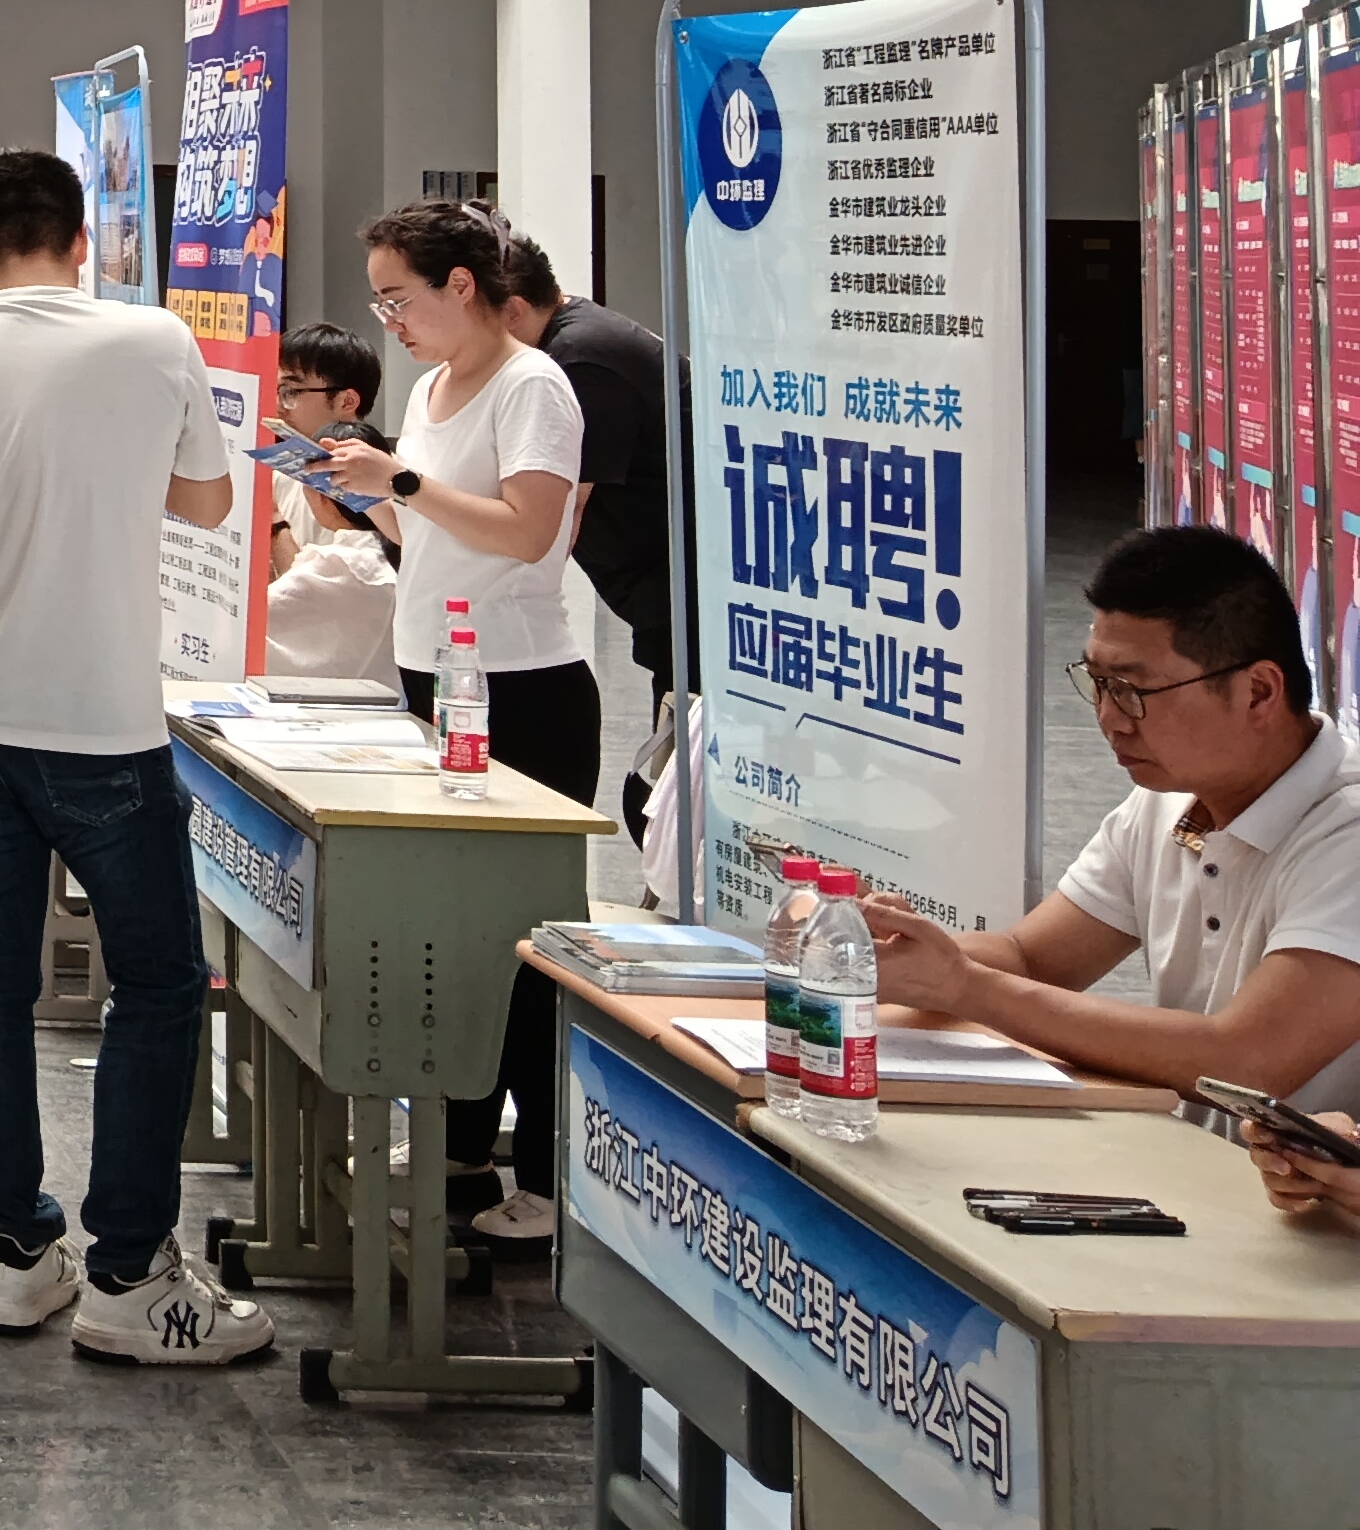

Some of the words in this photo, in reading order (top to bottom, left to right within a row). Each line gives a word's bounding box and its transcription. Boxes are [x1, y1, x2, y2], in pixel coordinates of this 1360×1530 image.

[824, 77, 934, 108] 浙江省著名商标企业
[827, 155, 936, 181] 浙江省优秀监理企业
[716, 178, 766, 203] 中环监理
[829, 194, 947, 219] 金华市建筑业龙头企业
[829, 234, 947, 257] 金华市建筑业先进企业
[829, 271, 947, 296] 金华市建筑业诚信企业
[830, 308, 985, 340] 金华市开发区政府质量奖单位
[720, 364, 827, 418] 加入我们
[844, 376, 963, 432] 成就未来
[179, 632, 211, 665] 实习生
[727, 602, 965, 736] 应届毕业生
[733, 754, 802, 808] 公司简介
[582, 1098, 1011, 1498] 浙江中环建设监理有限公司
